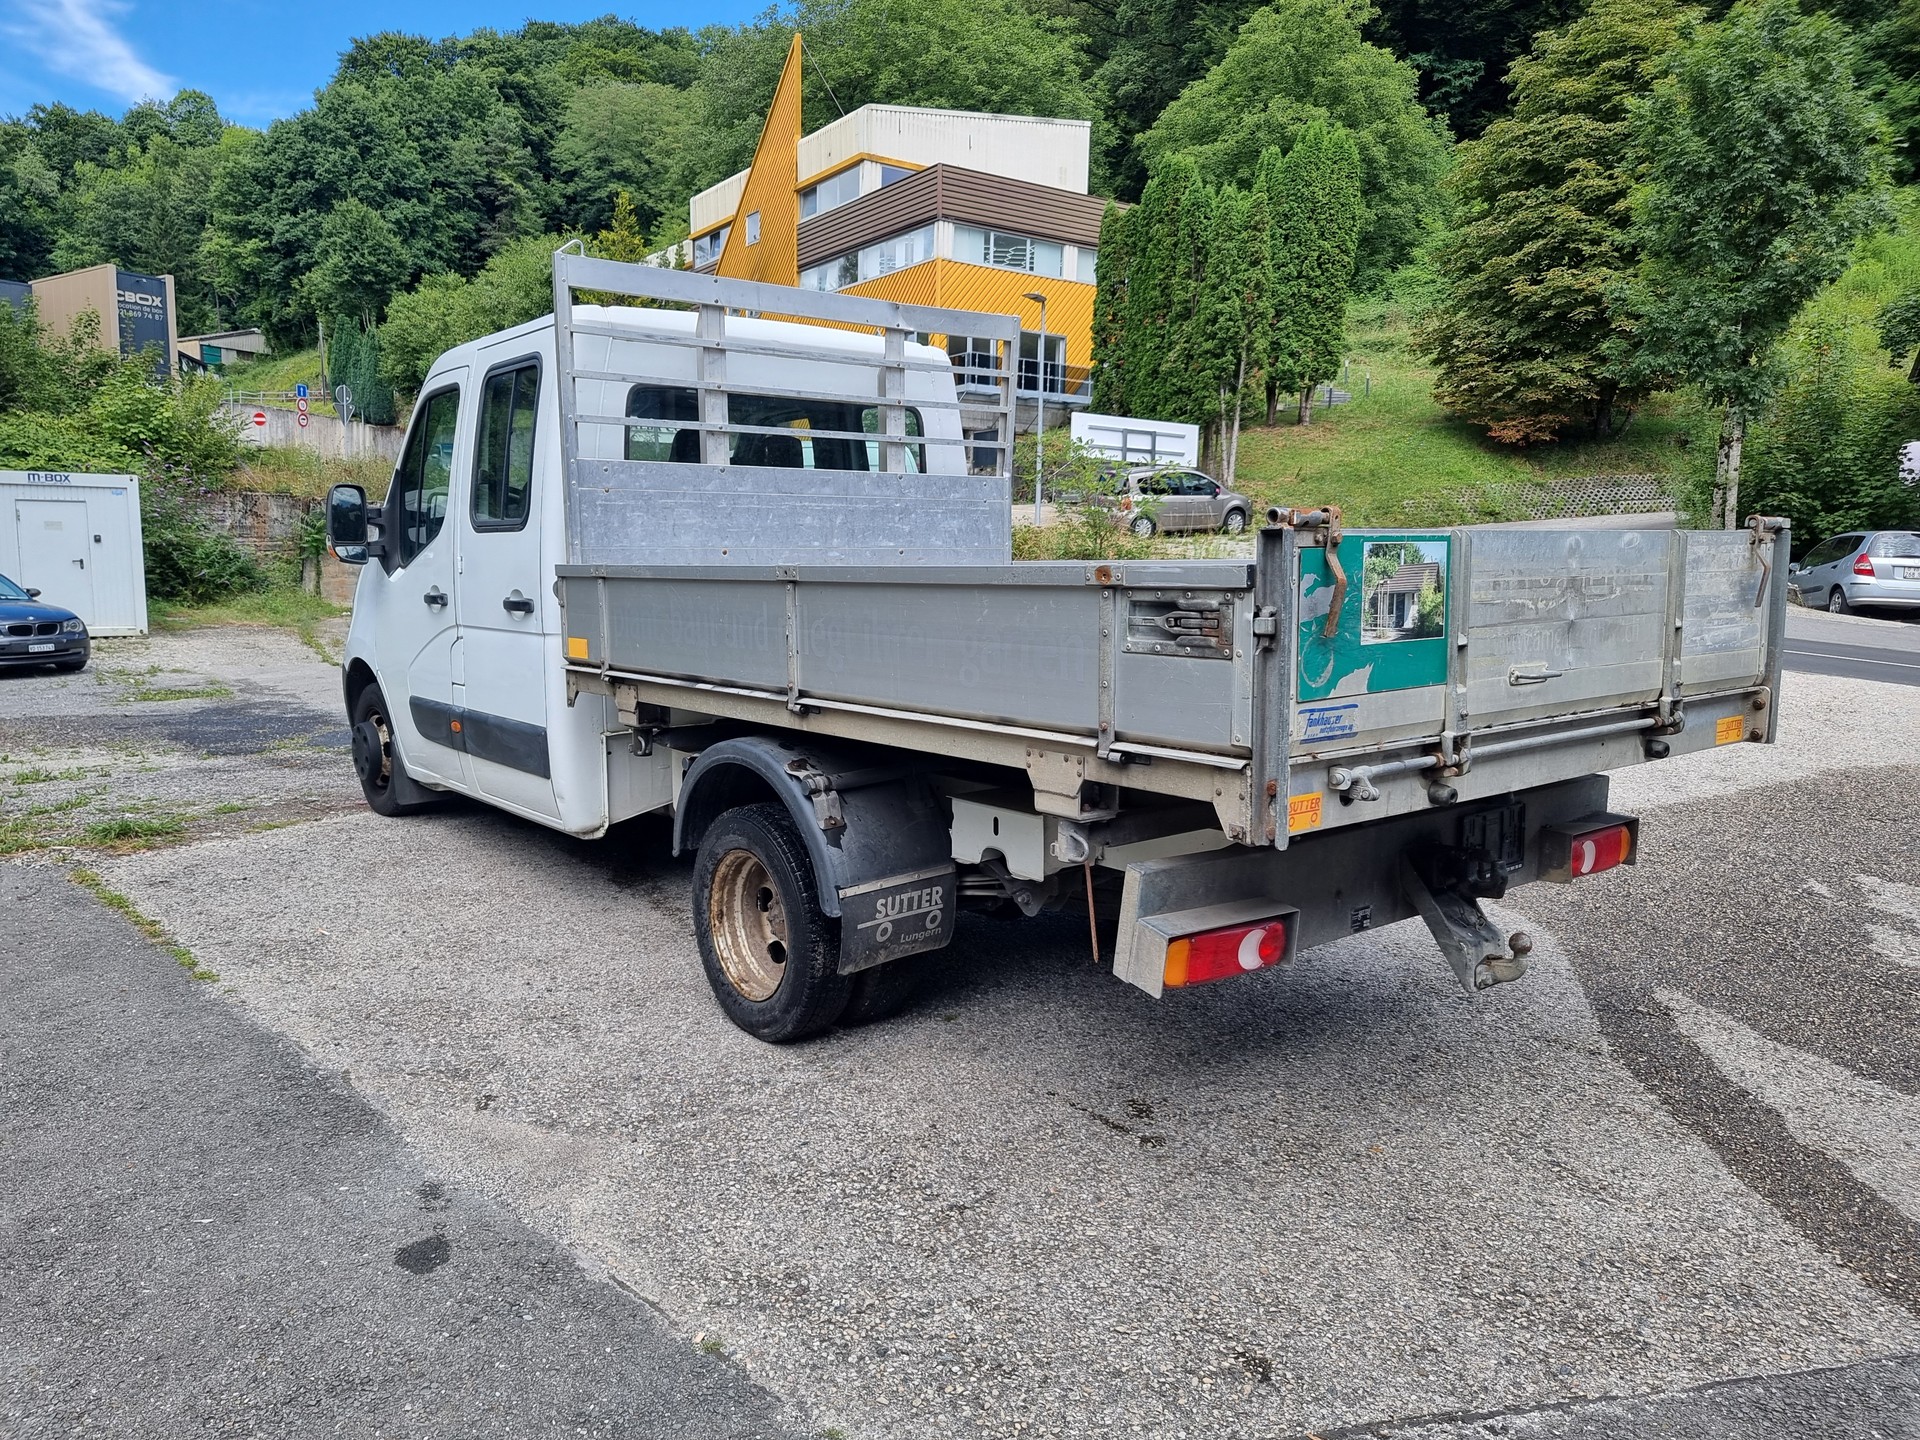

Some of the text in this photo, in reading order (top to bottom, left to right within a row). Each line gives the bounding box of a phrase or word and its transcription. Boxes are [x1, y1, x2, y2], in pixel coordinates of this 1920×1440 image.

[119, 303, 141, 311] ocation
[1289, 797, 1320, 813] SUTTER
[875, 886, 943, 919] SUTTER
[900, 927, 942, 943] Lungern
